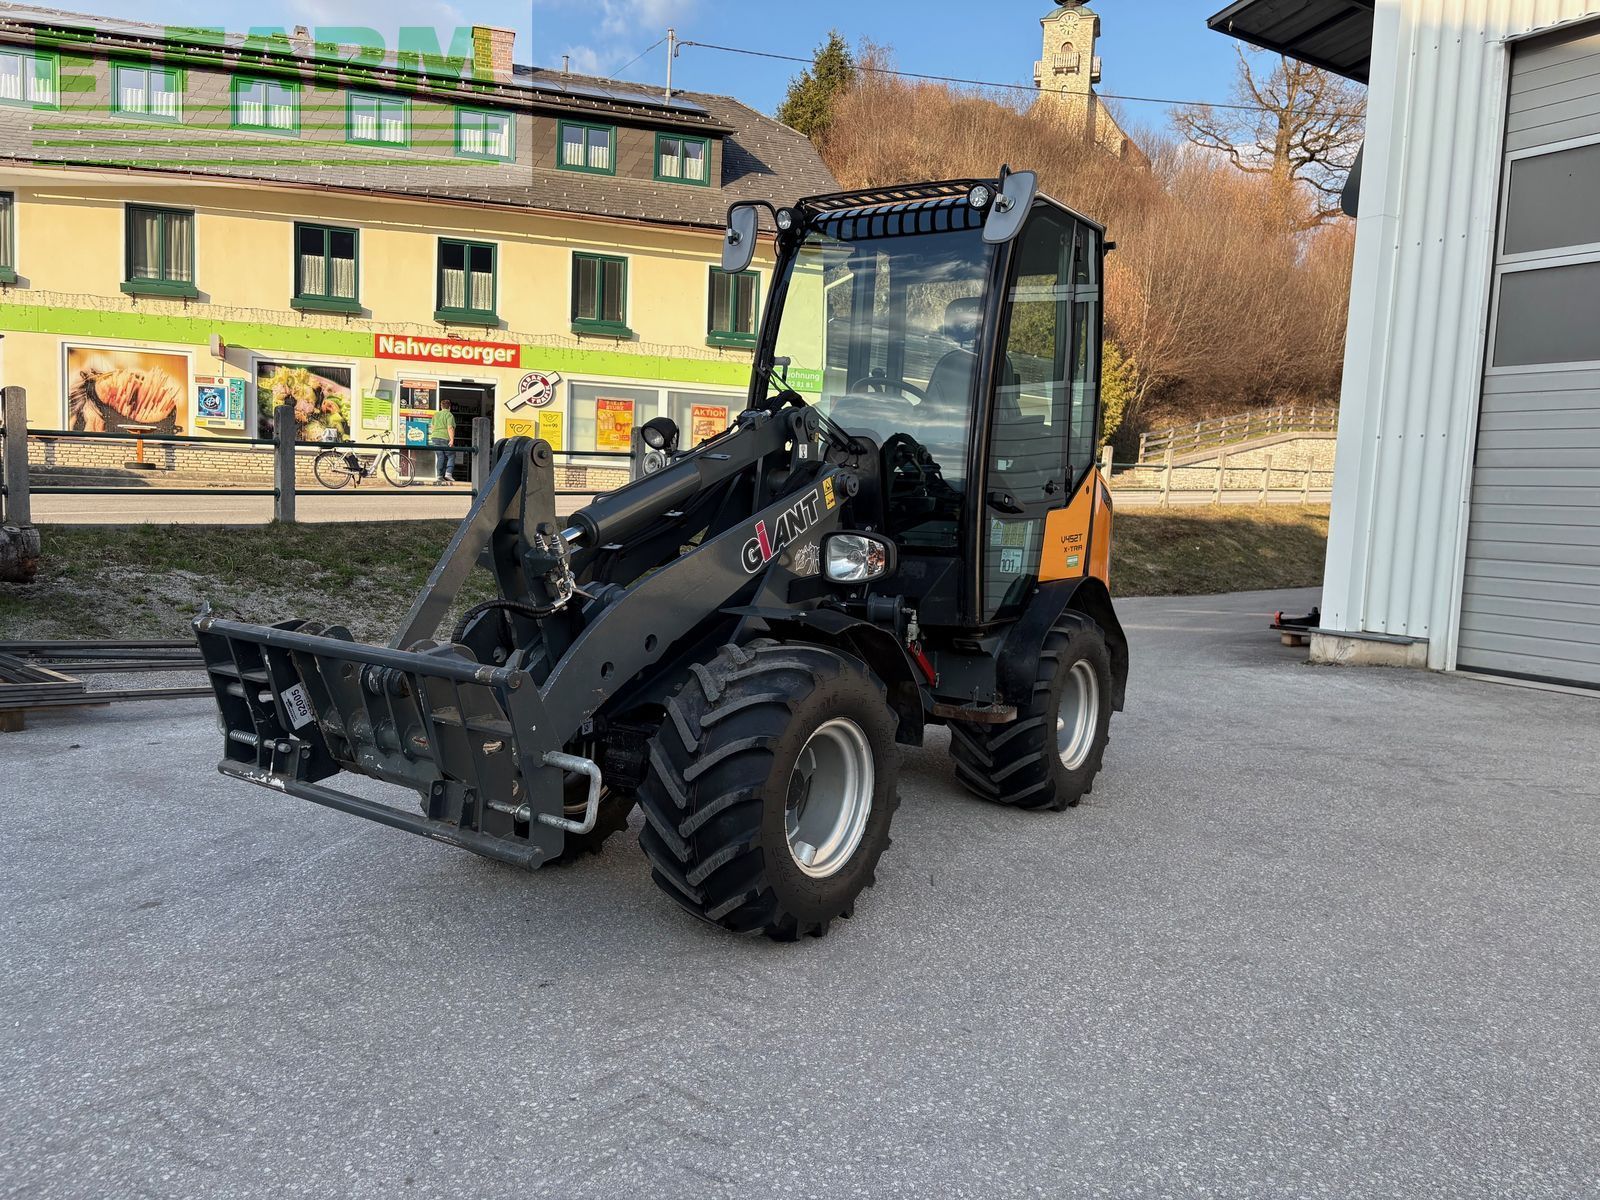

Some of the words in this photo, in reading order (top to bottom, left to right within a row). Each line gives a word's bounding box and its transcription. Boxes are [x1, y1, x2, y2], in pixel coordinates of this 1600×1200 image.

[379, 335, 516, 364] Nahversorger
[521, 374, 542, 391] TABAK
[694, 408, 725, 417] AKTION
[1060, 533, 1083, 544] V452T
[1001, 559, 1014, 571] 101
[291, 689, 308, 717] 62005
